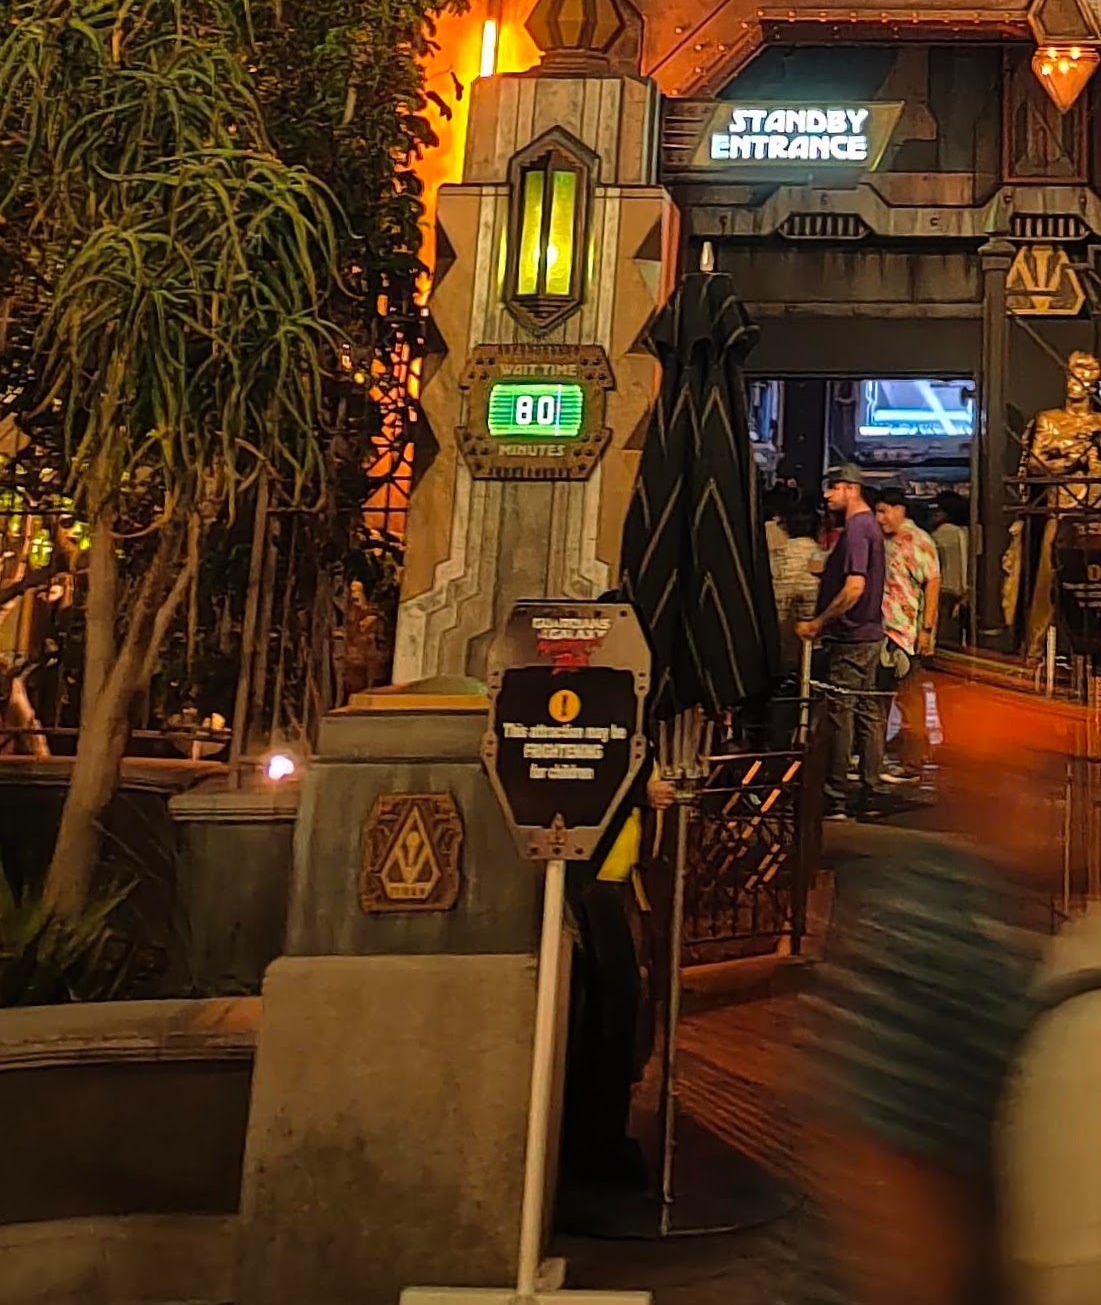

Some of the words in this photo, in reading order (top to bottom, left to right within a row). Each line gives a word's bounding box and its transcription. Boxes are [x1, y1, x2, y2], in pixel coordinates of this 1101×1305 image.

[729, 108, 869, 134] STANDBY
[711, 134, 868, 160] ENTRANCE
[500, 363, 540, 376] WAIT
[543, 363, 578, 376] TIME
[515, 395, 555, 426] 80
[498, 444, 566, 457] MINUTES
[532, 617, 611, 629] GUARDIANS
